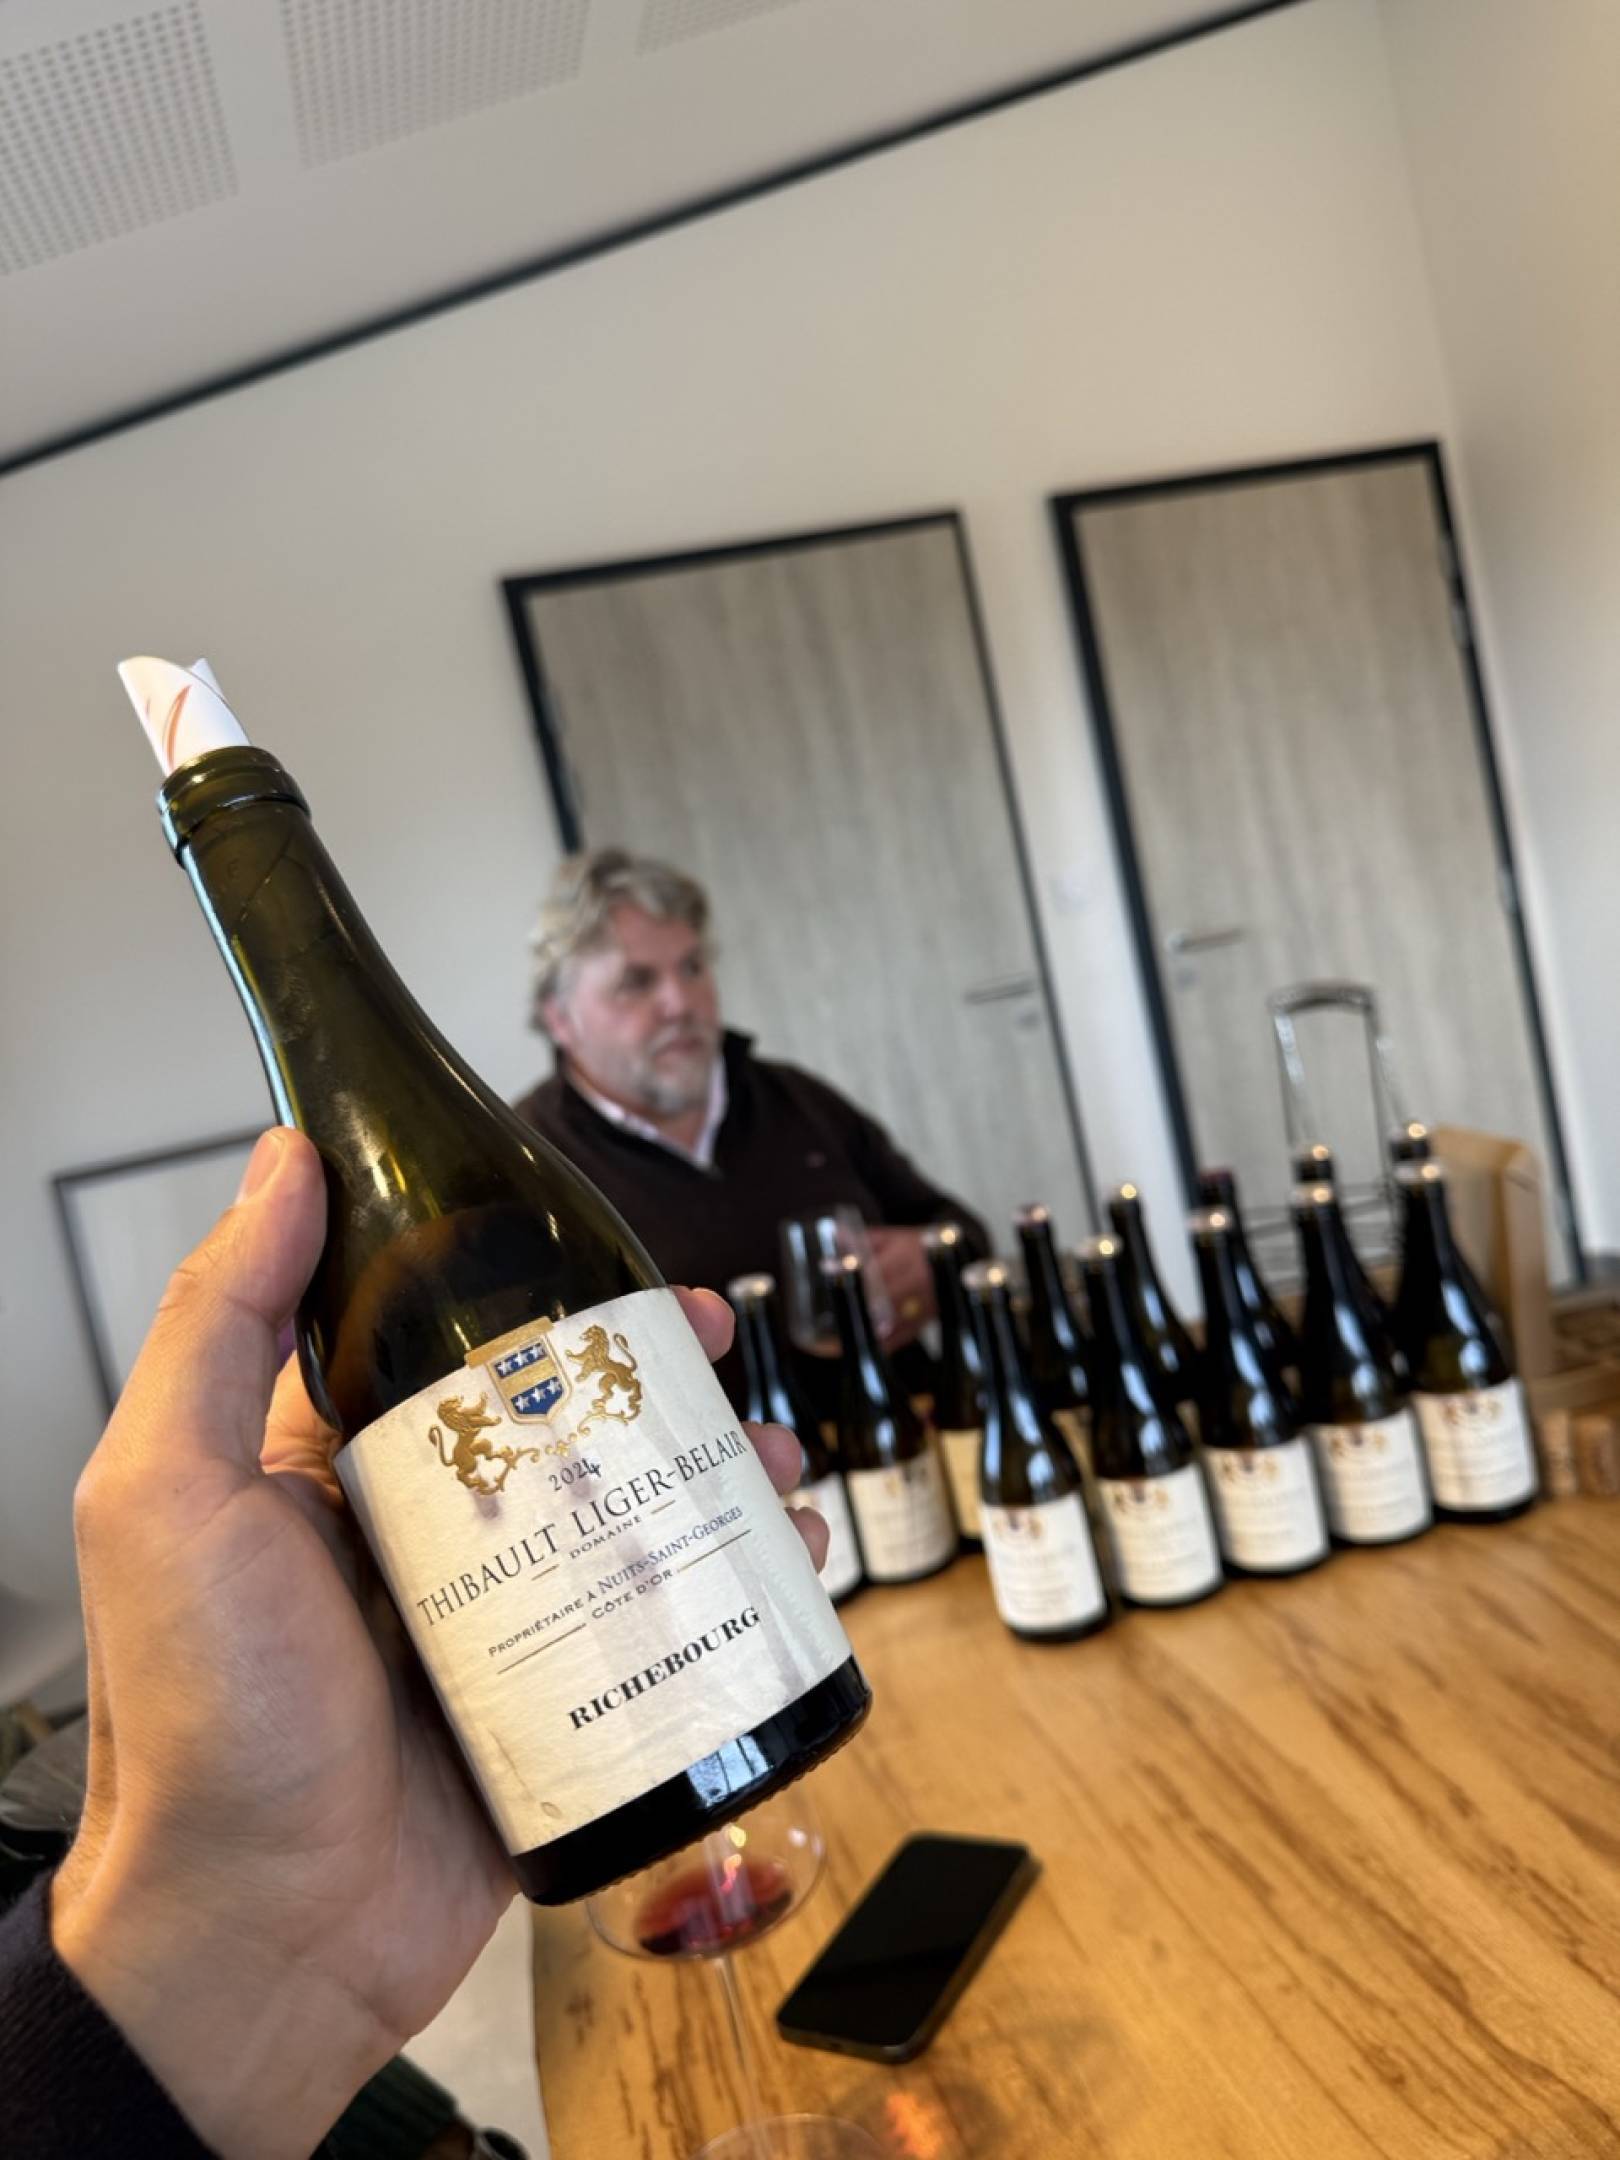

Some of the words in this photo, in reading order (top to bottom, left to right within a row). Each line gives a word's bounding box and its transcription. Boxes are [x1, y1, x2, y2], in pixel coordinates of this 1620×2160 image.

[548, 1457, 602, 1491] 2024
[416, 1524, 558, 1626] THIBAULT
[571, 1430, 747, 1536] LIGER-BELAIR
[570, 1515, 642, 1559] DOMAINE
[635, 1568, 673, 1595] D'OR
[567, 1605, 761, 1730] RICHEBOURG
